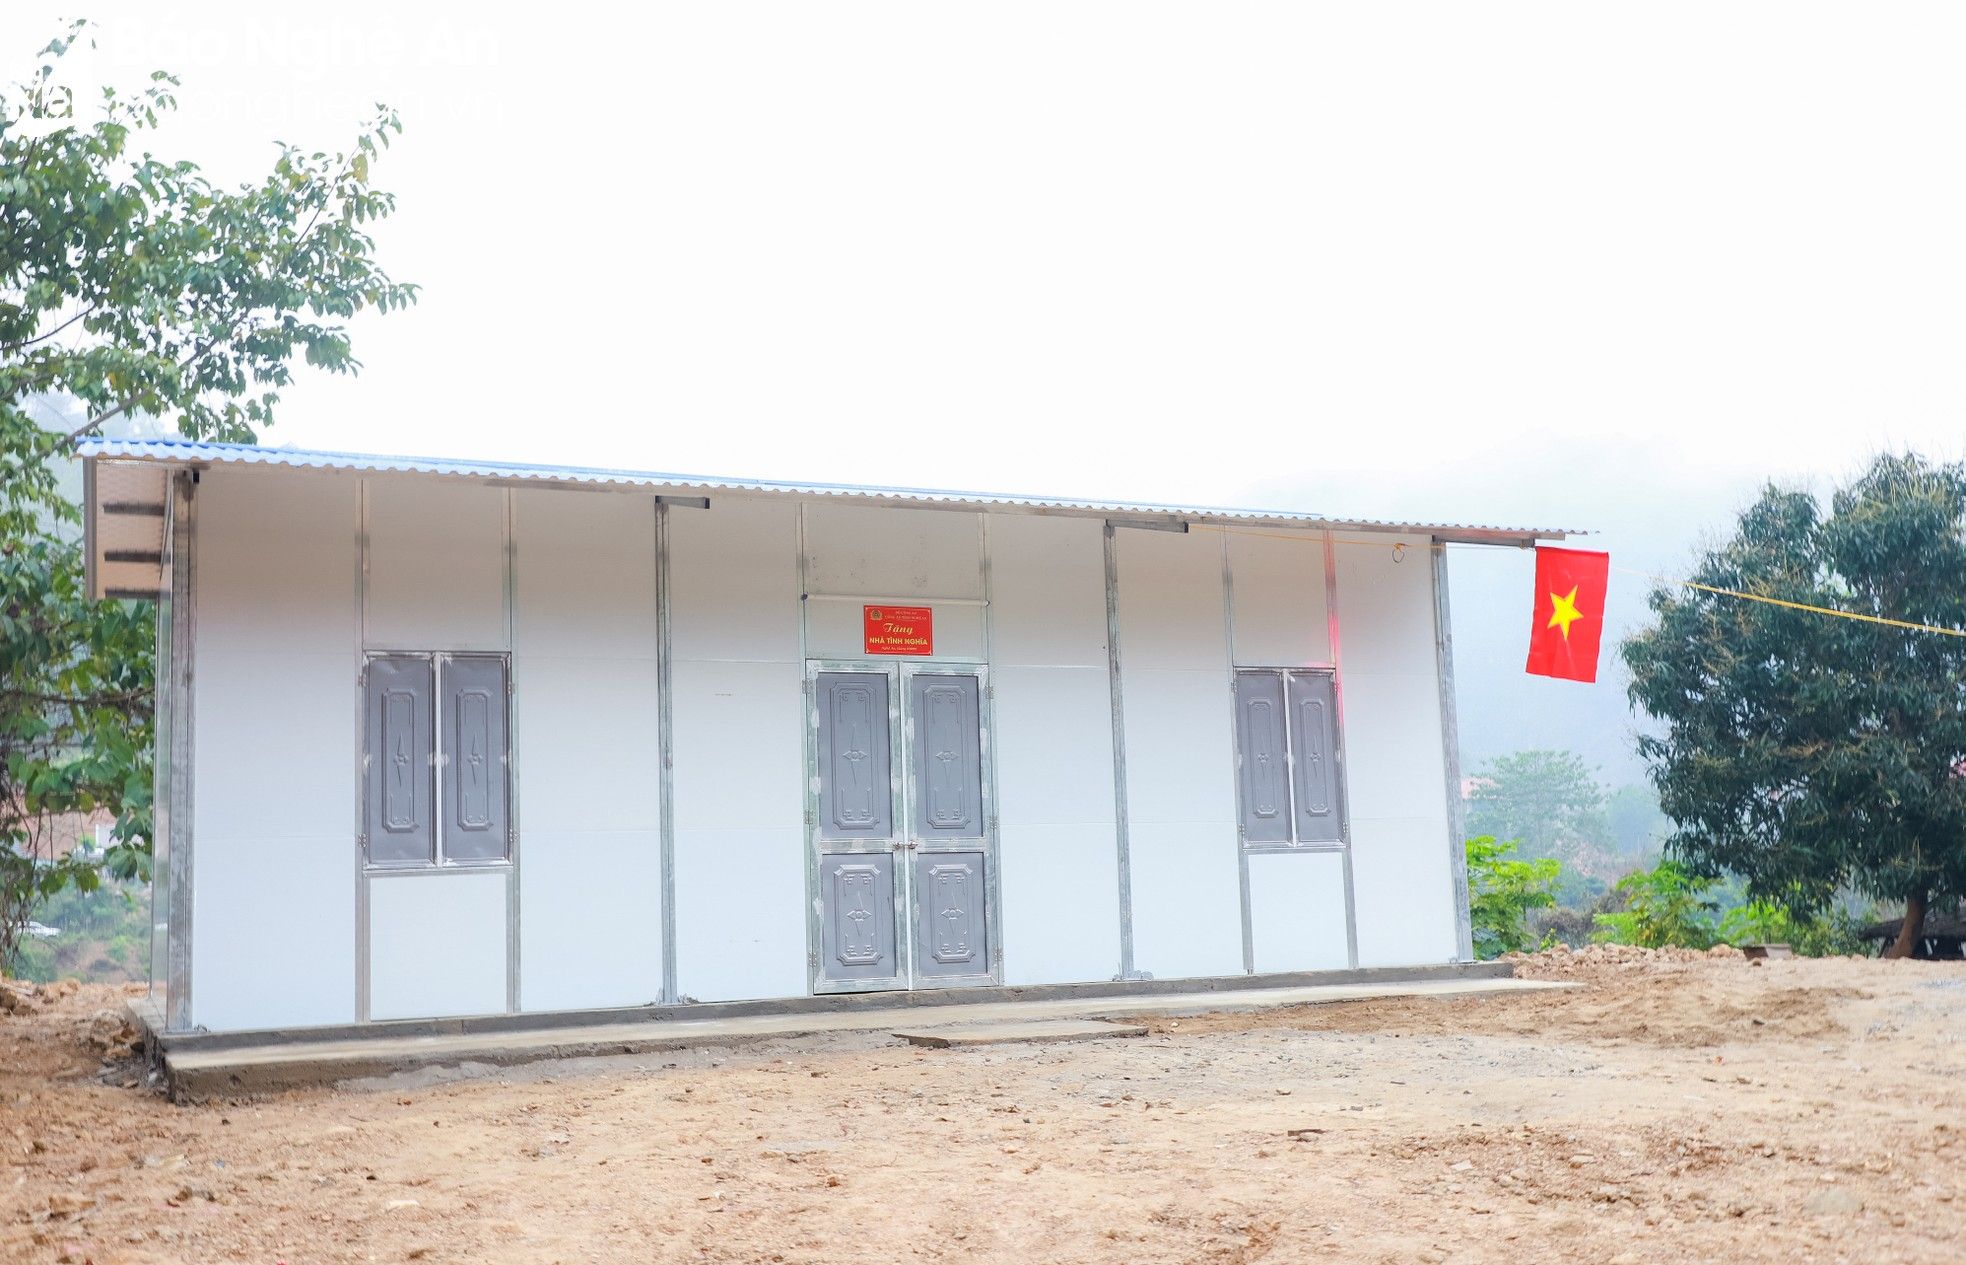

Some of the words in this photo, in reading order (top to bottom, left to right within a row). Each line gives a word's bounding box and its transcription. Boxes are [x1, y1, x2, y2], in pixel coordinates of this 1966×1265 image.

[883, 622, 913, 635] Tặng
[869, 636, 885, 645] NHÀ
[887, 636, 902, 645] TÌNH
